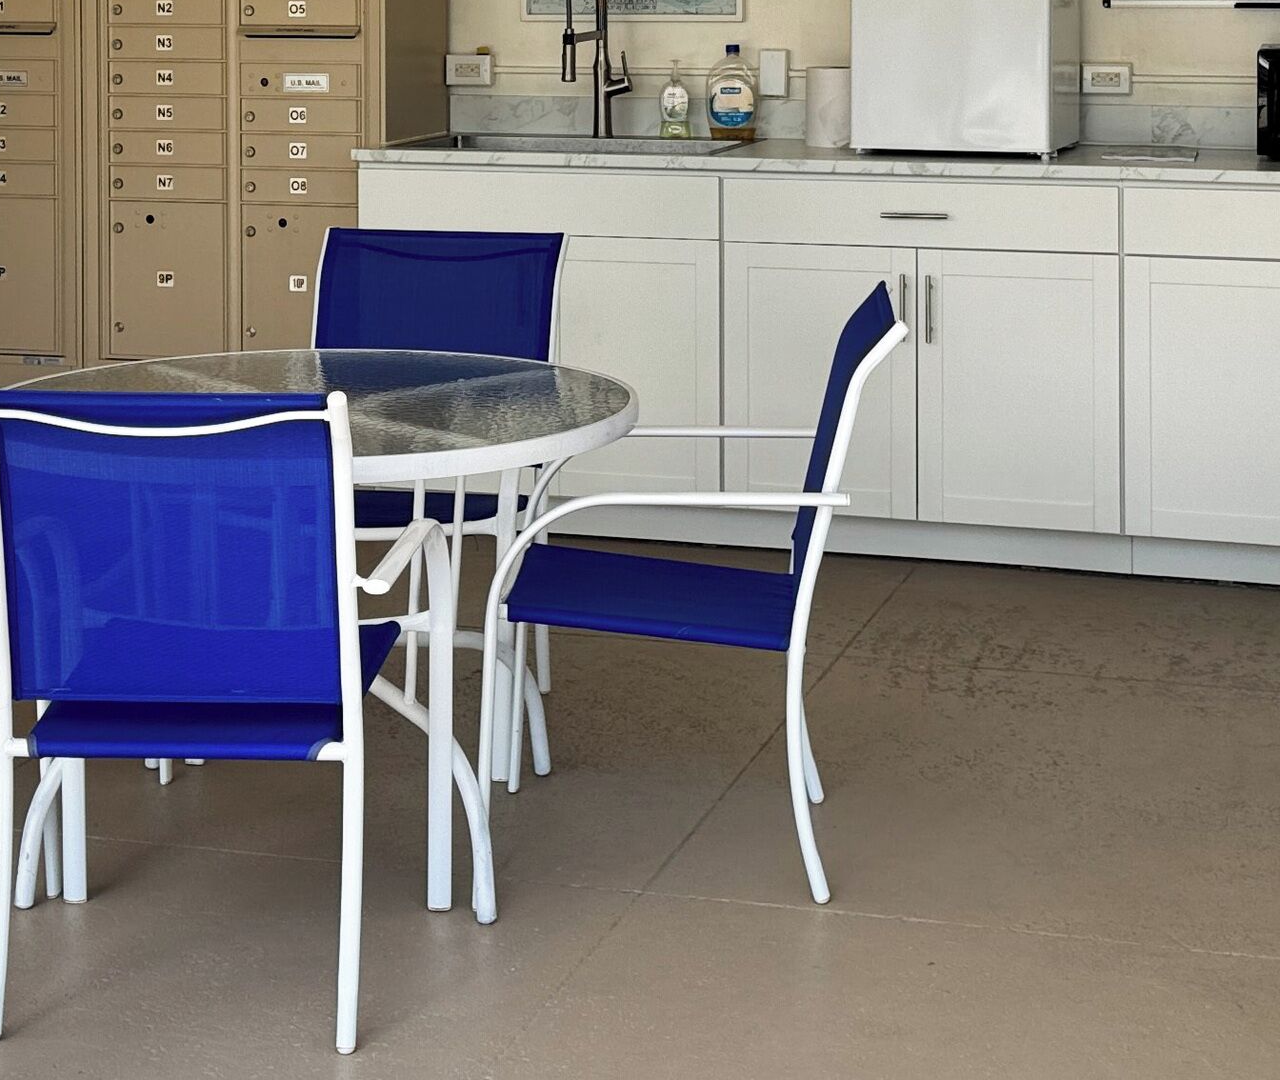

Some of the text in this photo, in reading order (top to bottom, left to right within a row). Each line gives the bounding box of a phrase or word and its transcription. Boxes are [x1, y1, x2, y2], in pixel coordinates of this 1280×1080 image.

[157, 2, 173, 13] N2
[289, 3, 306, 15] O5
[157, 37, 172, 48] N3
[157, 72, 173, 83] N4
[157, 107, 173, 118] N5
[290, 109, 306, 121] O6
[157, 142, 173, 153] N6
[290, 145, 306, 156] O7
[158, 177, 174, 188] N7
[291, 180, 307, 191] O8
[158, 273, 173, 284] 9P
